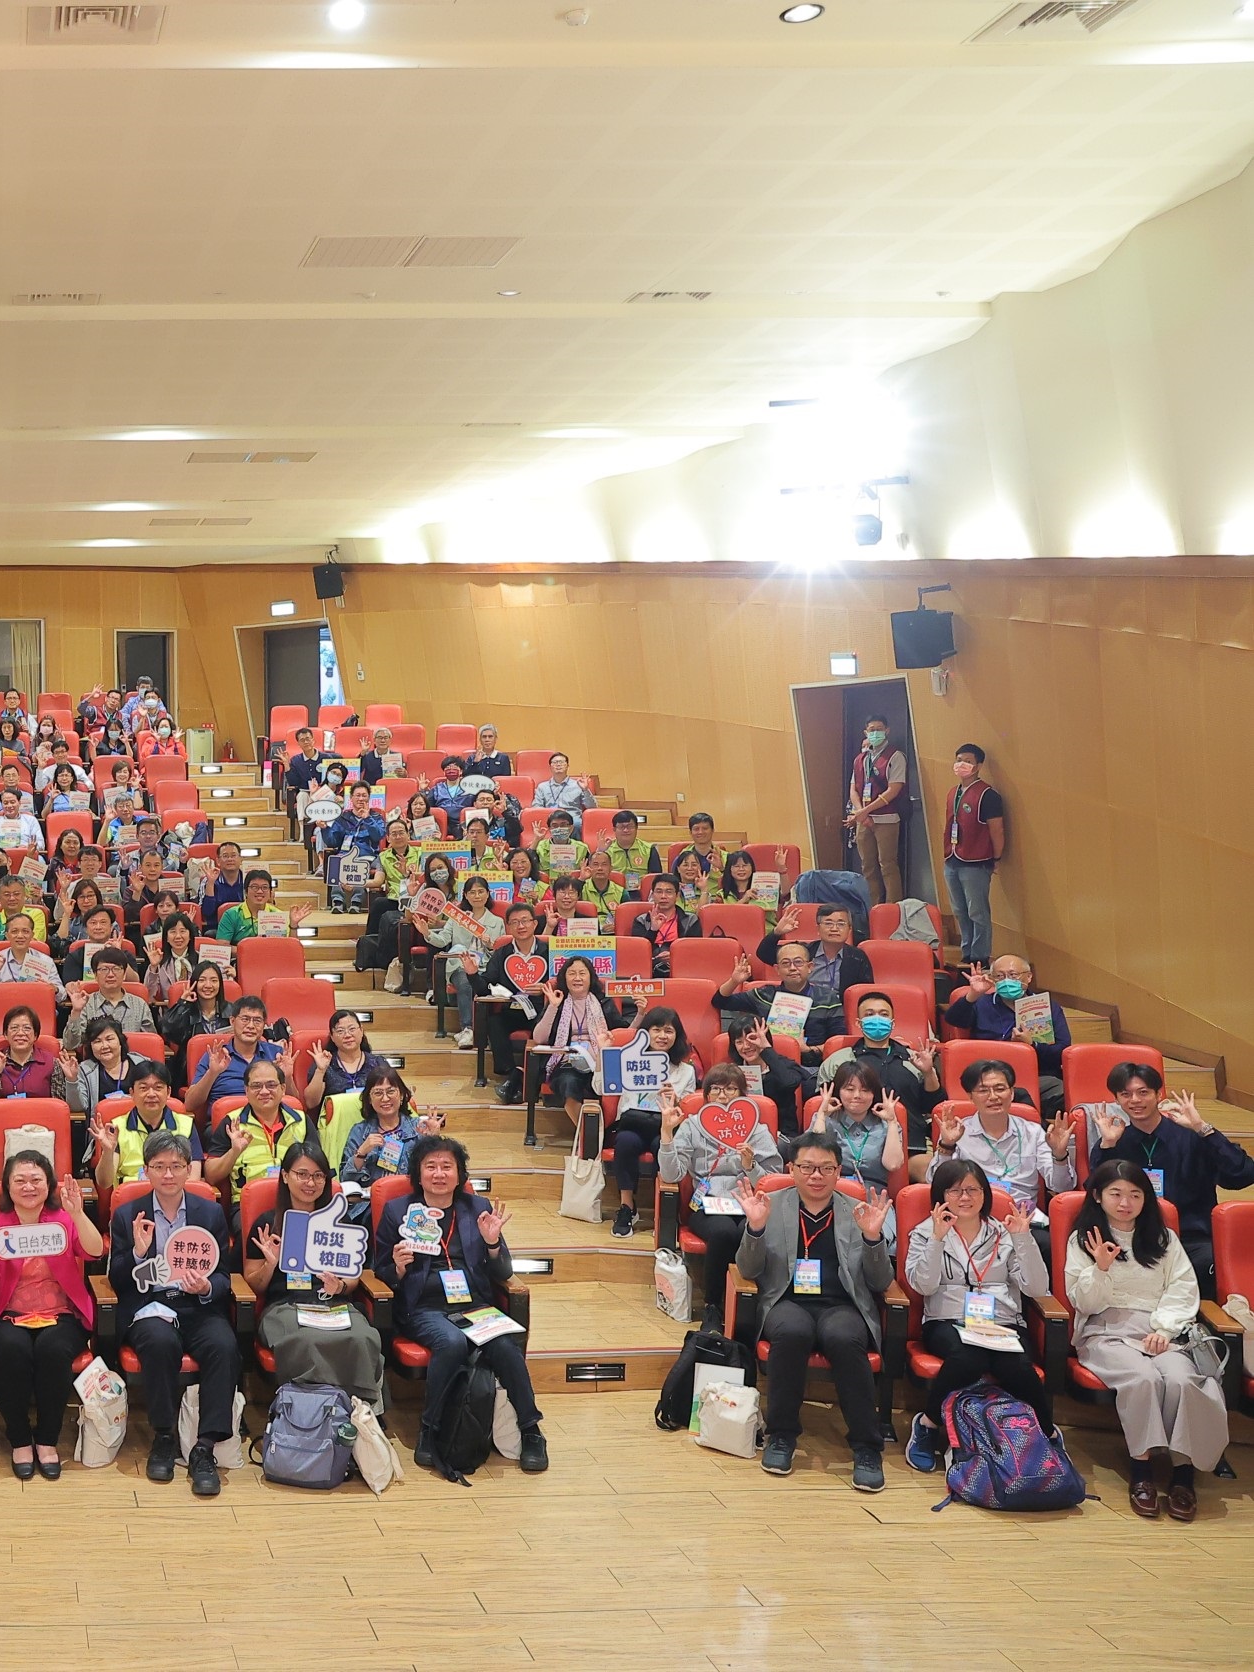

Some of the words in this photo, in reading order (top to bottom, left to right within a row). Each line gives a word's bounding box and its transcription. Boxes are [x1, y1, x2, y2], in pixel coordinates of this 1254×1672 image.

[342, 864, 358, 873] 防災
[346, 874, 362, 882] 校園
[515, 962, 537, 972] 心有
[554, 957, 613, 975] 南縣
[514, 972, 536, 984] 防災
[626, 1060, 651, 1072] 防災
[633, 1074, 658, 1087] 教育
[713, 1108, 744, 1123] 心有
[717, 1124, 748, 1140] 防災
[18, 1233, 63, 1249] 日台友情
[313, 1230, 344, 1248] 防災
[174, 1240, 211, 1255] 我防災
[402, 1241, 439, 1253] HIZUOKA!!
[173, 1256, 211, 1271] 我驕傲
[319, 1250, 351, 1268] 校園
